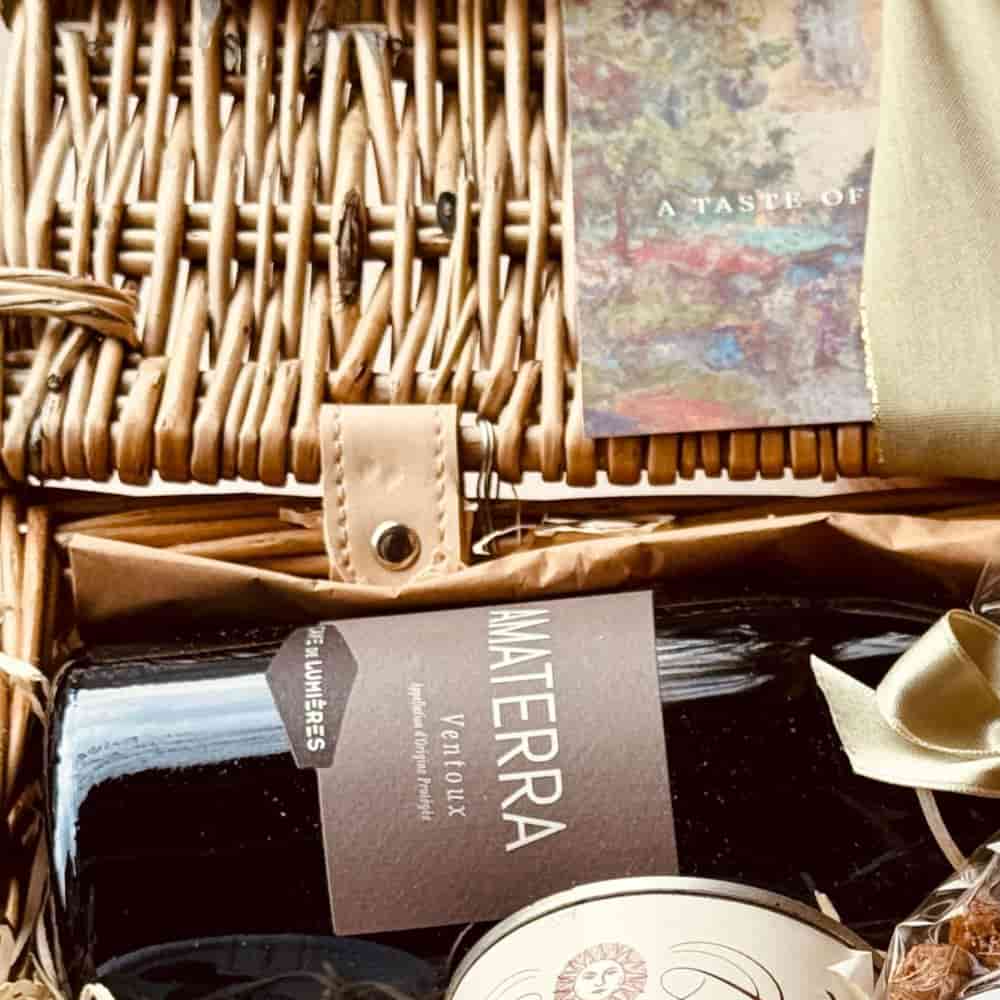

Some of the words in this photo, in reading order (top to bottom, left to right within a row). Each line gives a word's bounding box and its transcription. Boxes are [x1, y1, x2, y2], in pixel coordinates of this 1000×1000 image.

[657, 199, 676, 217] A
[693, 189, 802, 214] TASTE
[820, 187, 865, 207] OF
[304, 659, 327, 753] LUMIÈRES
[488, 608, 567, 852] AMATERRA
[440, 714, 466, 817] Ventoux
